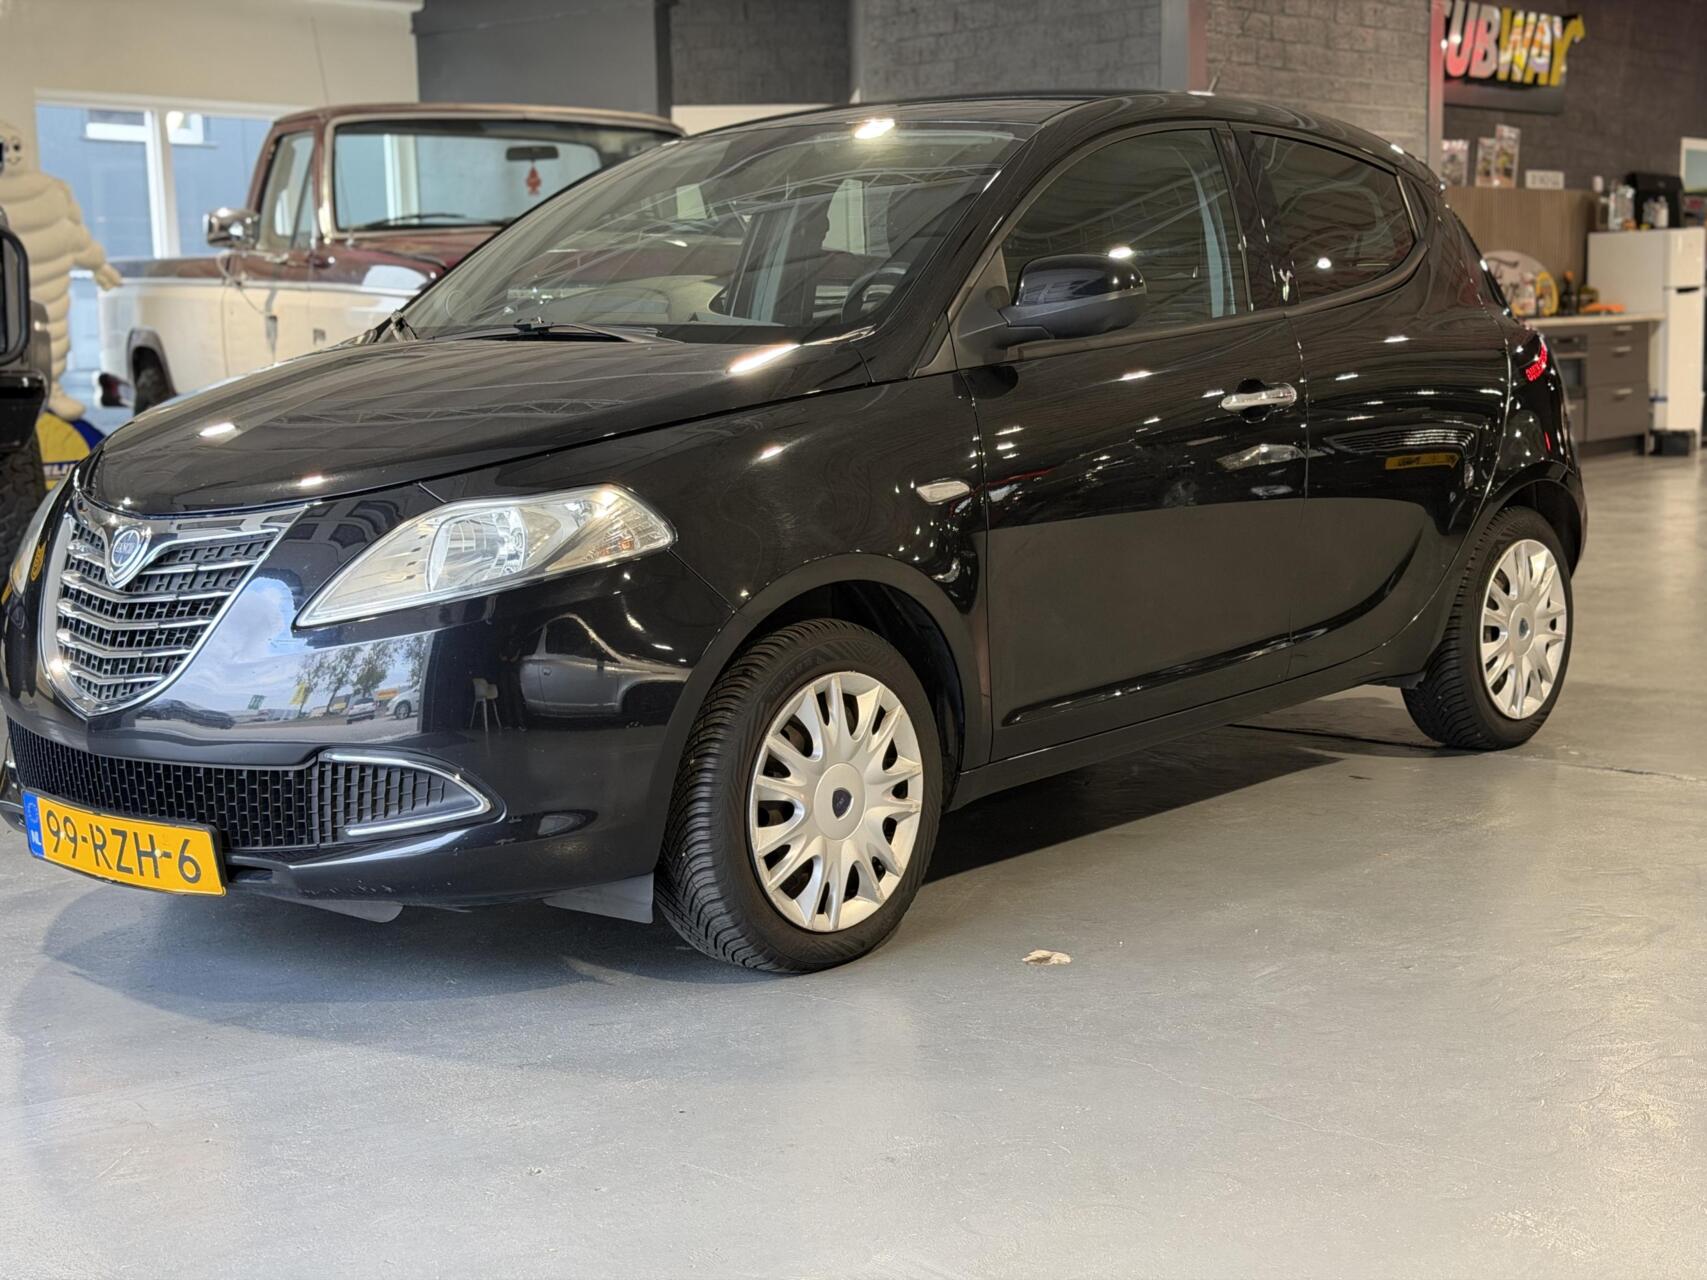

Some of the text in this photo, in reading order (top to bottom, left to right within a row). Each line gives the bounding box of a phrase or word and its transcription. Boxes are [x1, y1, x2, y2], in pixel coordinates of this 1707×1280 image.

[1443, 0, 1585, 87] UBWAY
[31, 830, 42, 846] NL
[46, 809, 202, 884] 99-RZH-6
